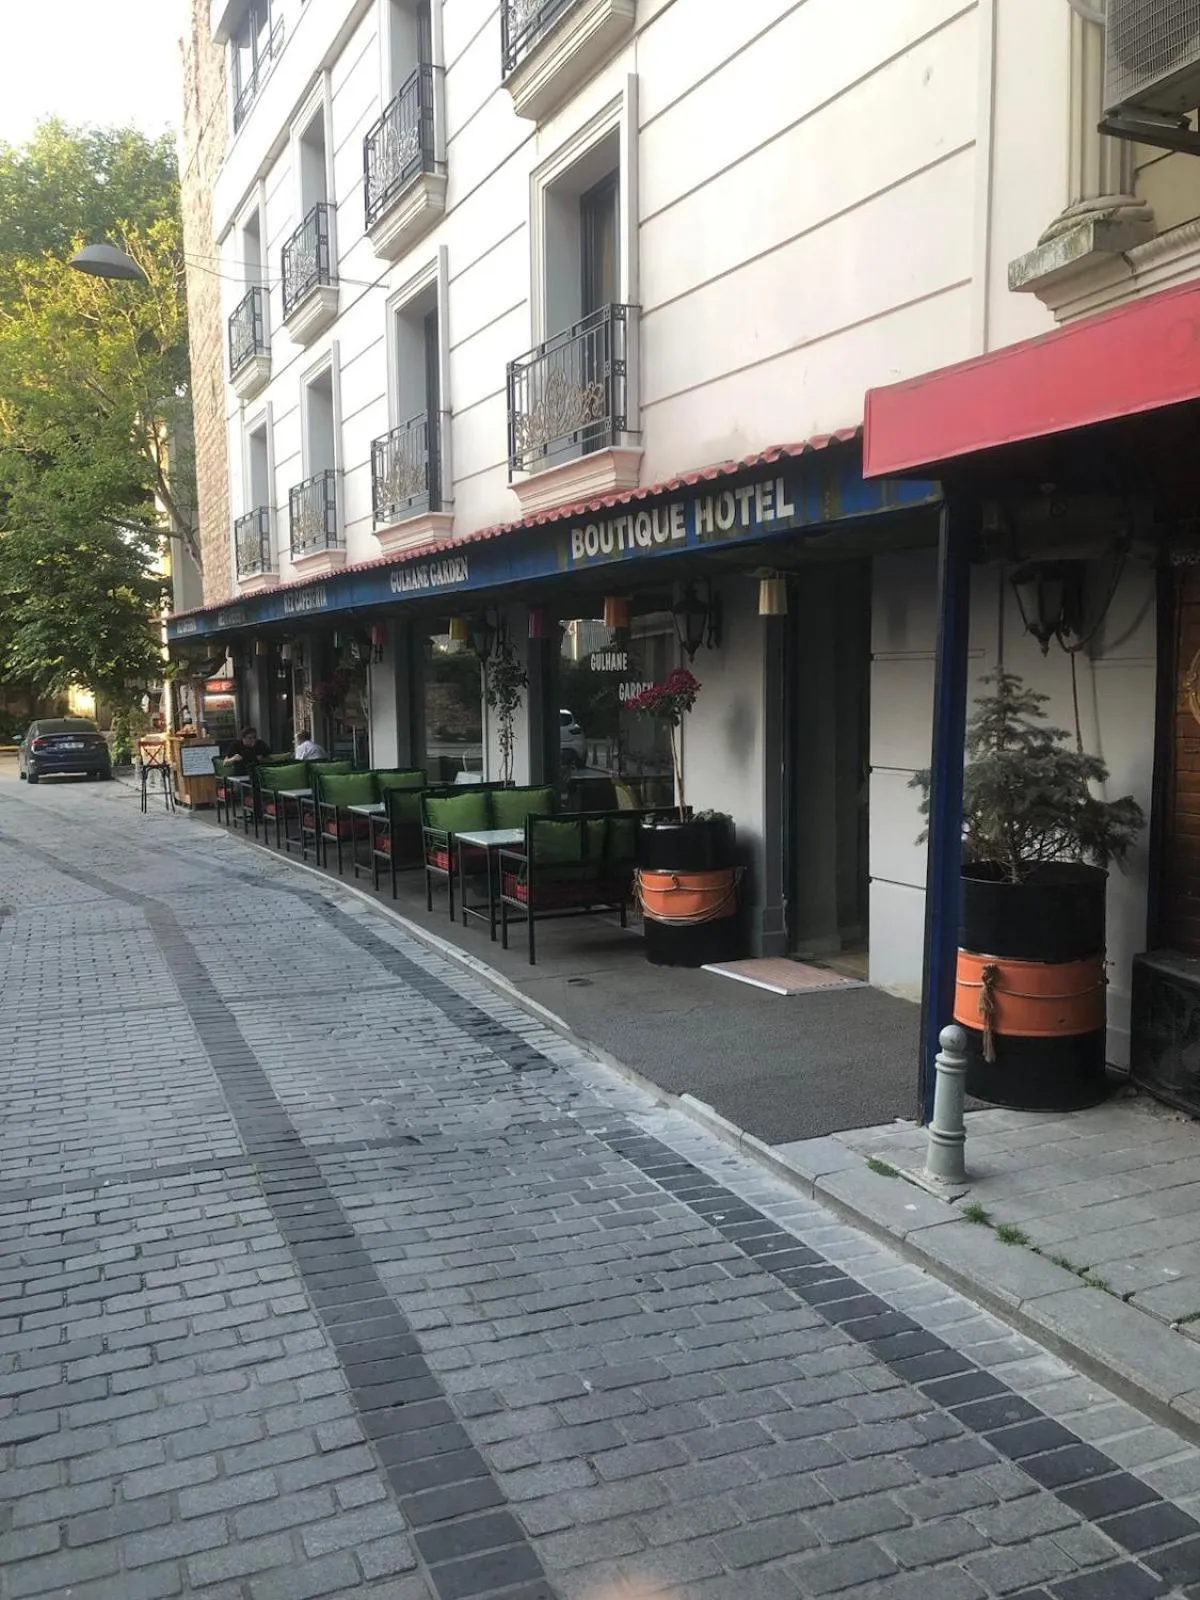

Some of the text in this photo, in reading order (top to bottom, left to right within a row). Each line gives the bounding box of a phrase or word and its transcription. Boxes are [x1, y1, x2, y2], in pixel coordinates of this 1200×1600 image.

[571, 477, 795, 560] BOUTIQUE HOTEL
[430, 555, 469, 587] GARDEN
